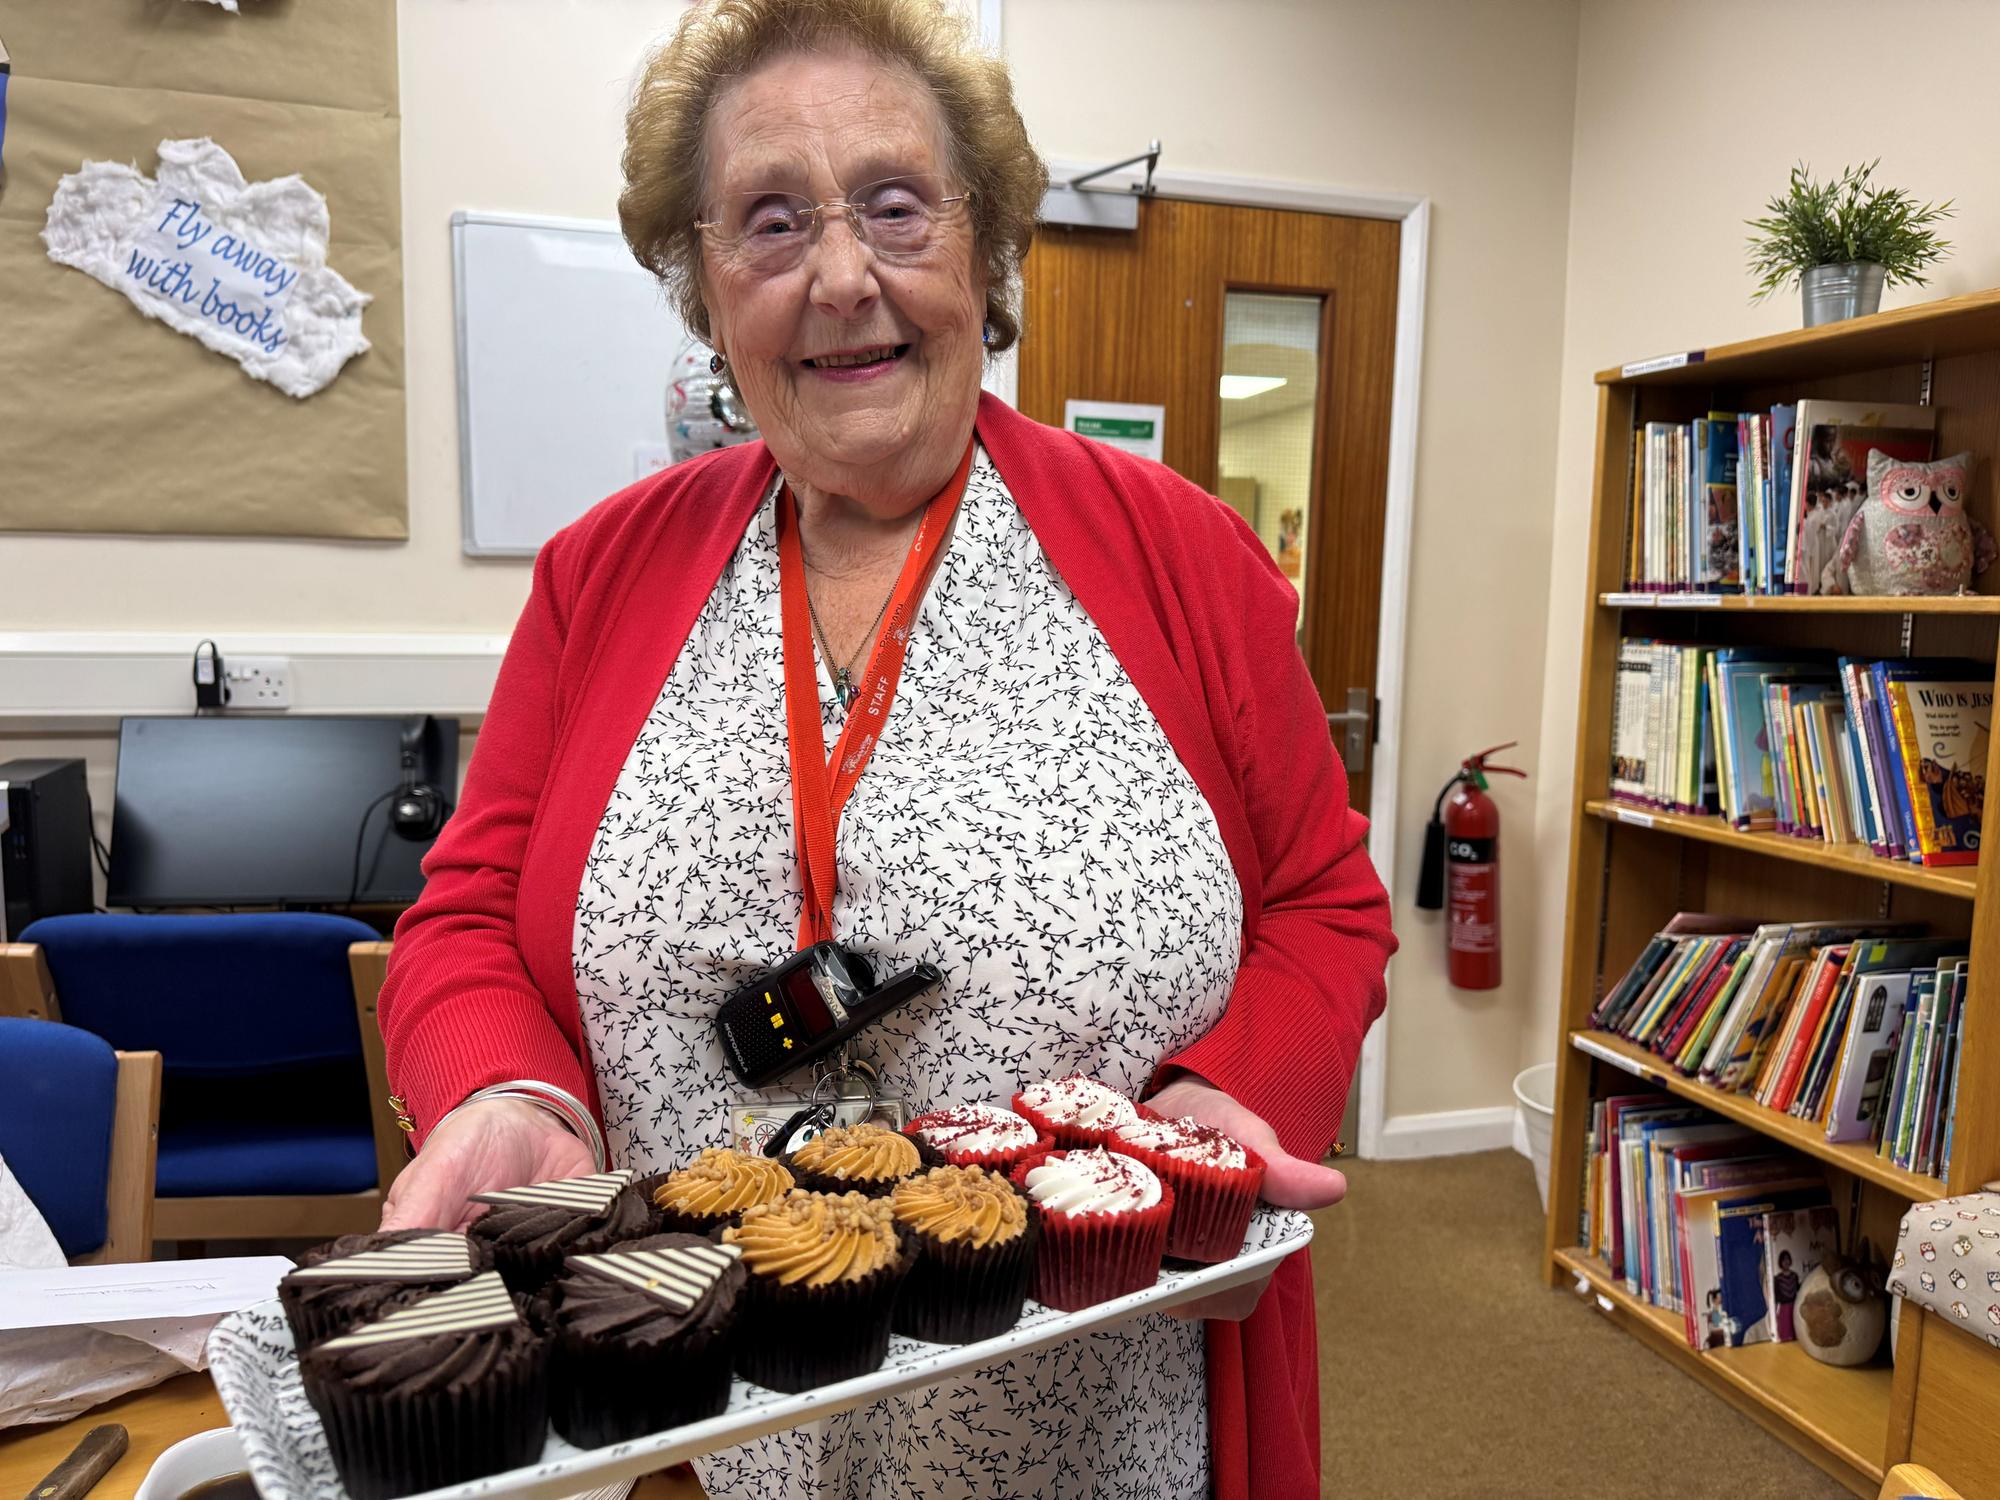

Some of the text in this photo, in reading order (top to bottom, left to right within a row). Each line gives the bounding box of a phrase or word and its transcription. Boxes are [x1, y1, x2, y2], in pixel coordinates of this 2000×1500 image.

[157, 198, 298, 298] Fly away
[126, 248, 288, 354] with books
[868, 675, 889, 716] STAFF
[1918, 689, 1954, 707] WHO
[1956, 693, 1968, 707] IS
[724, 1022, 749, 1073] MOTOROLA
